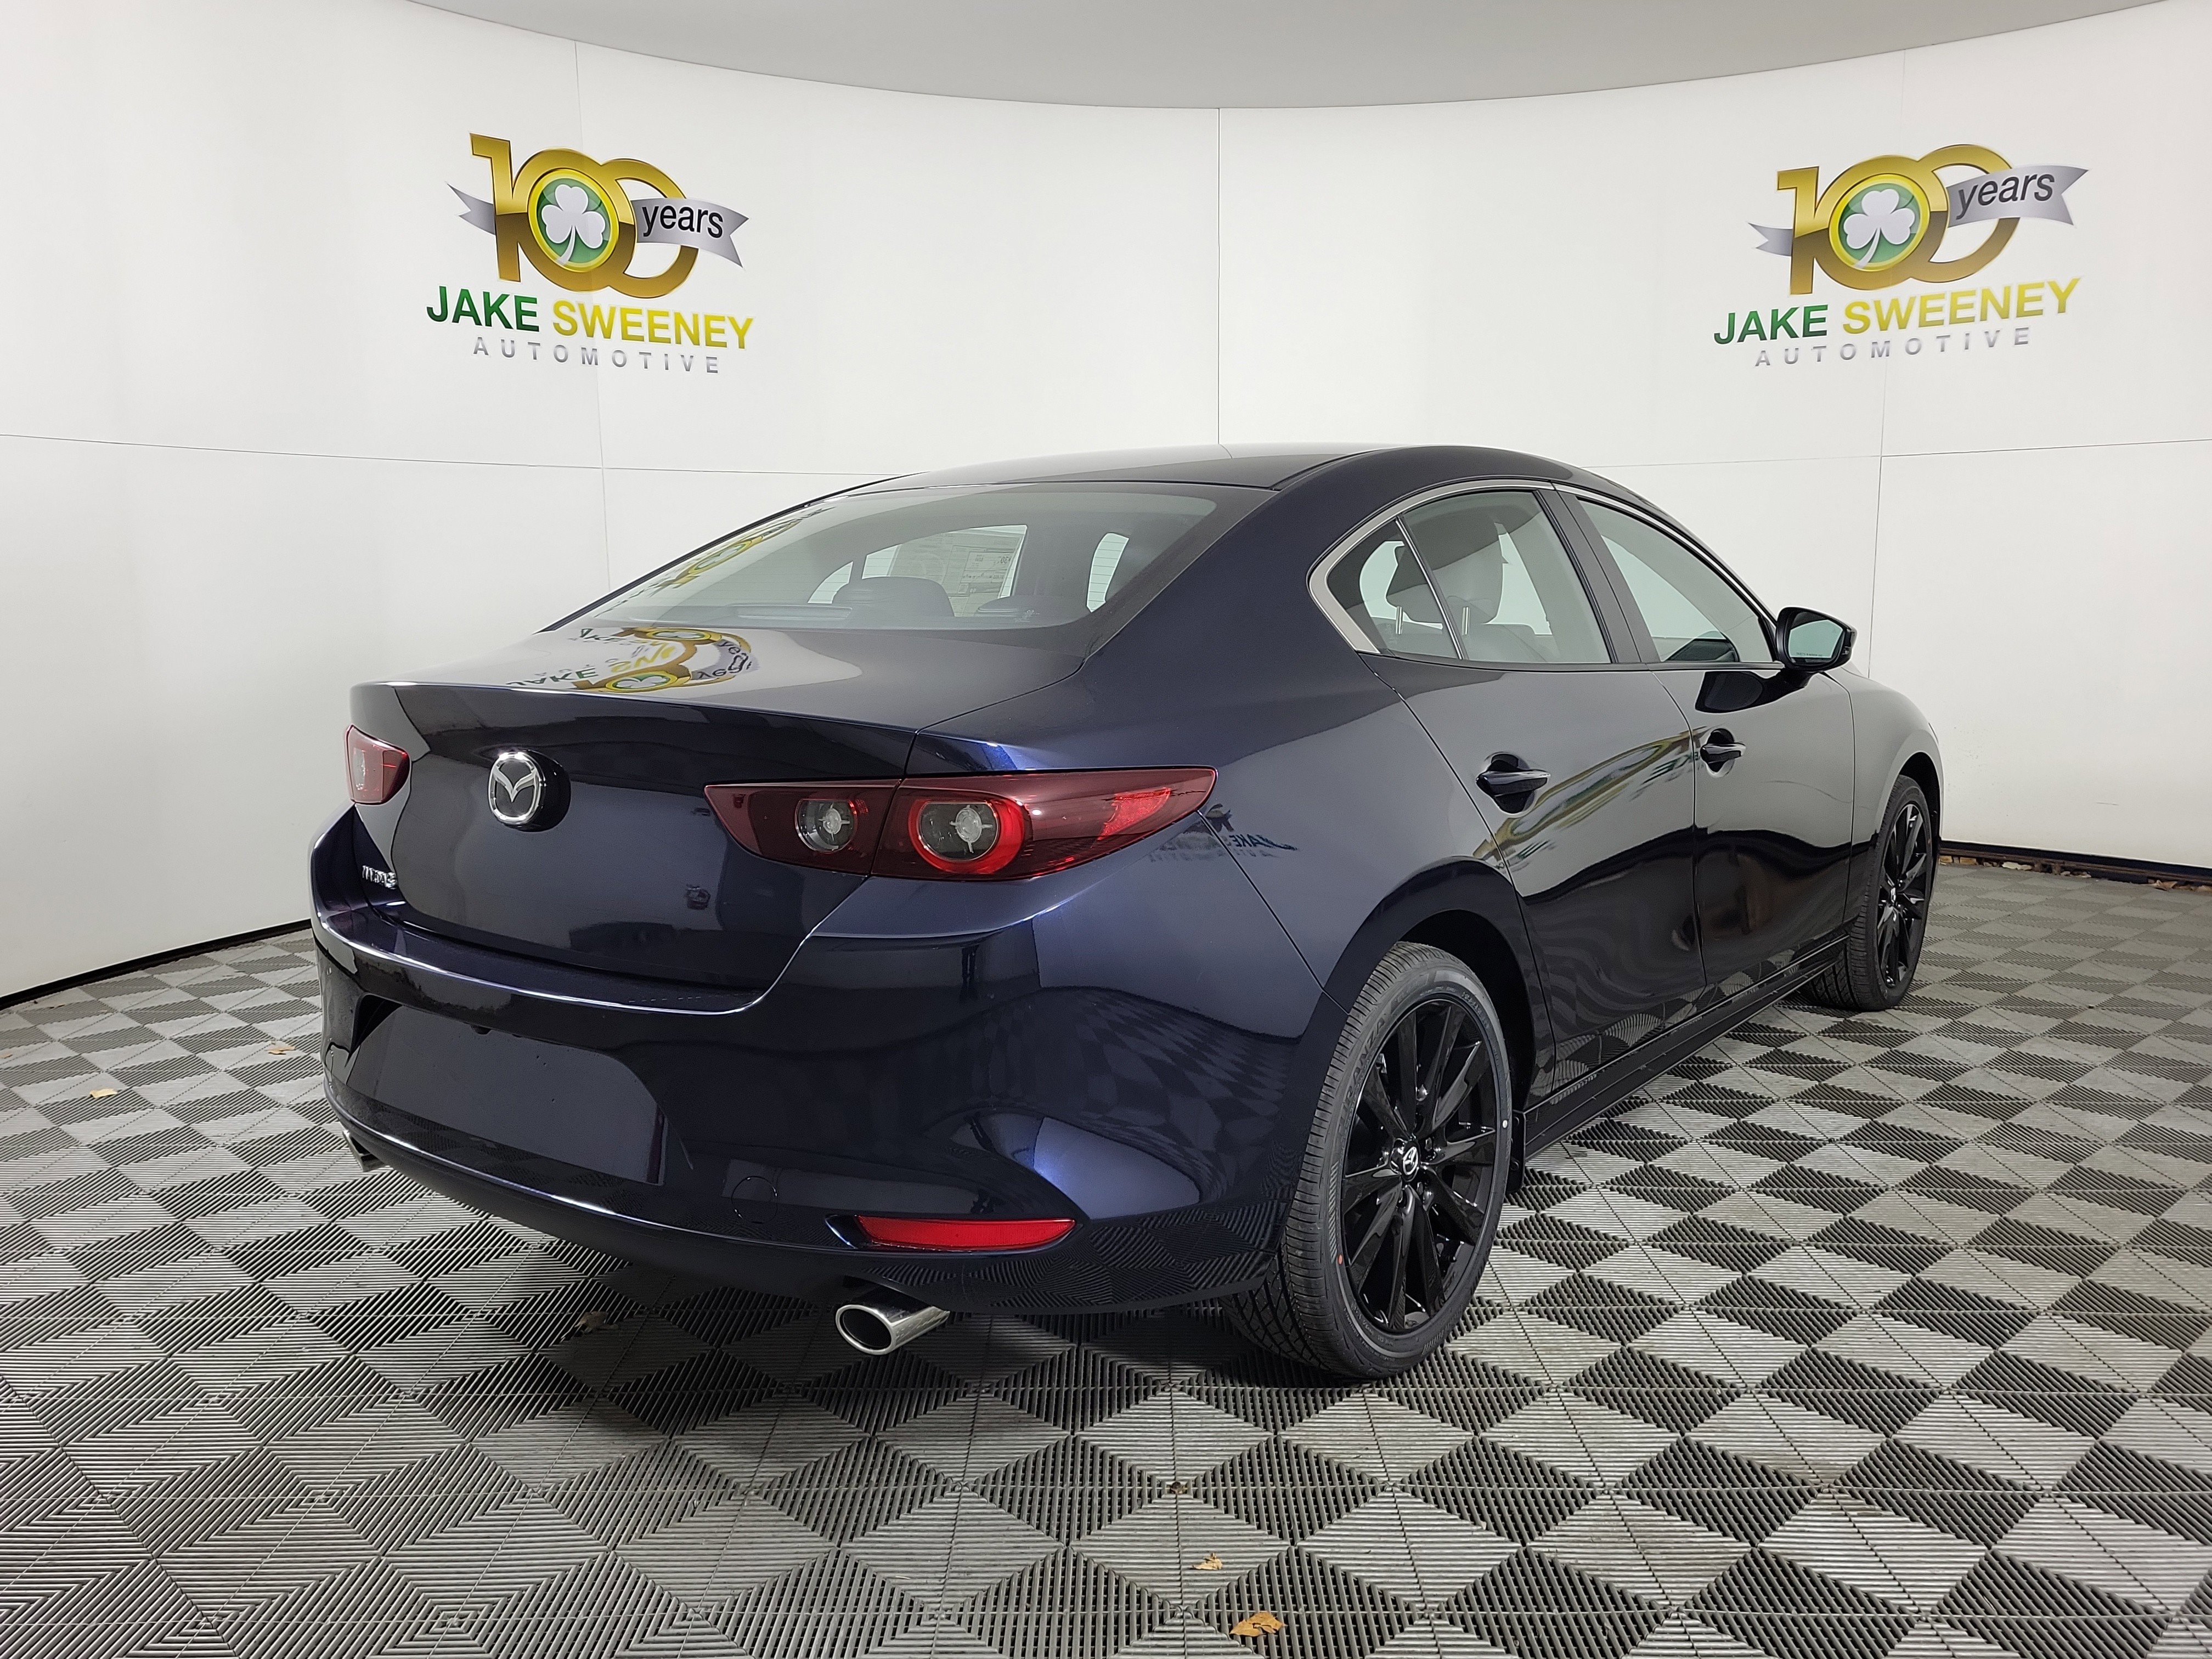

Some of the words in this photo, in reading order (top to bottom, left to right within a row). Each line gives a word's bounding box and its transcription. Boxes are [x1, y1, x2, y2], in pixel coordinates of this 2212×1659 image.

[1956, 173, 2056, 220] years
[642, 205, 723, 238] years
[426, 286, 540, 332] JAKE
[553, 300, 754, 349] SWEENEY
[1714, 304, 1829, 345] JAKE
[1843, 278, 2081, 334] SWEENEY
[473, 337, 719, 374] AUTOMOTIVE
[1755, 327, 2030, 368] AUTOMOTIVE
